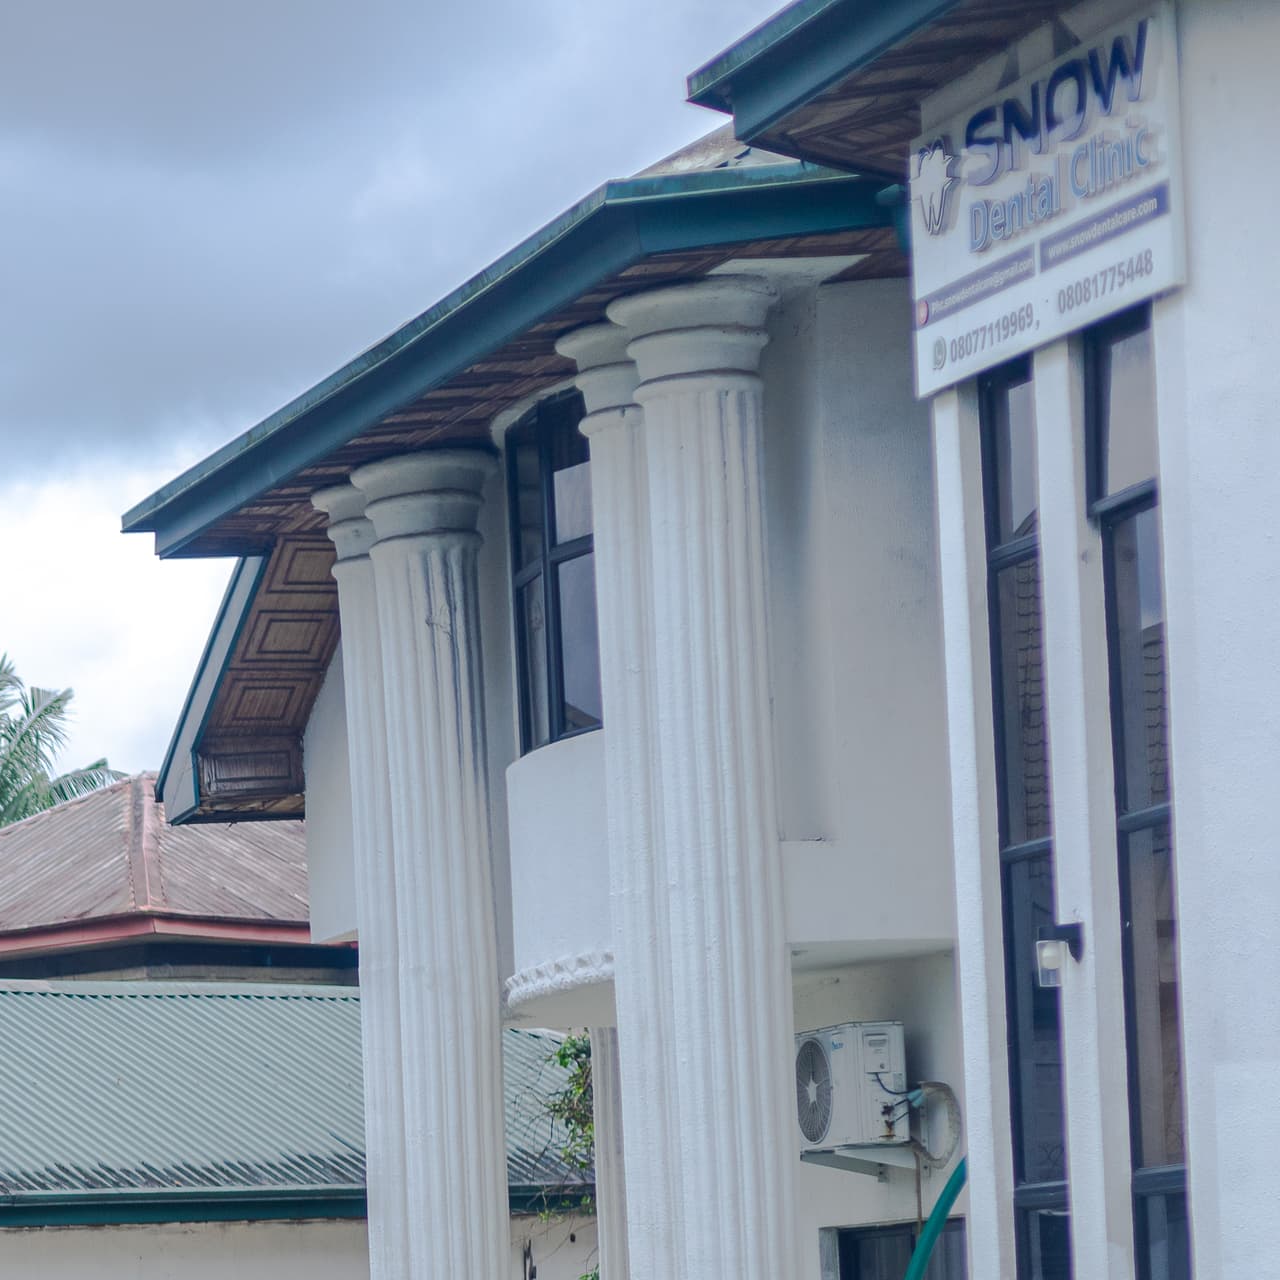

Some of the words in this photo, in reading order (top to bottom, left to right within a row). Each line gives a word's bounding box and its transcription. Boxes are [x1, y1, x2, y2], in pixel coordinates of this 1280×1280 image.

[965, 18, 1150, 187] SNOW
[969, 157, 1062, 253] Dental
[1070, 122, 1153, 200] Clinic
[1057, 248, 1154, 314] 08081775448
